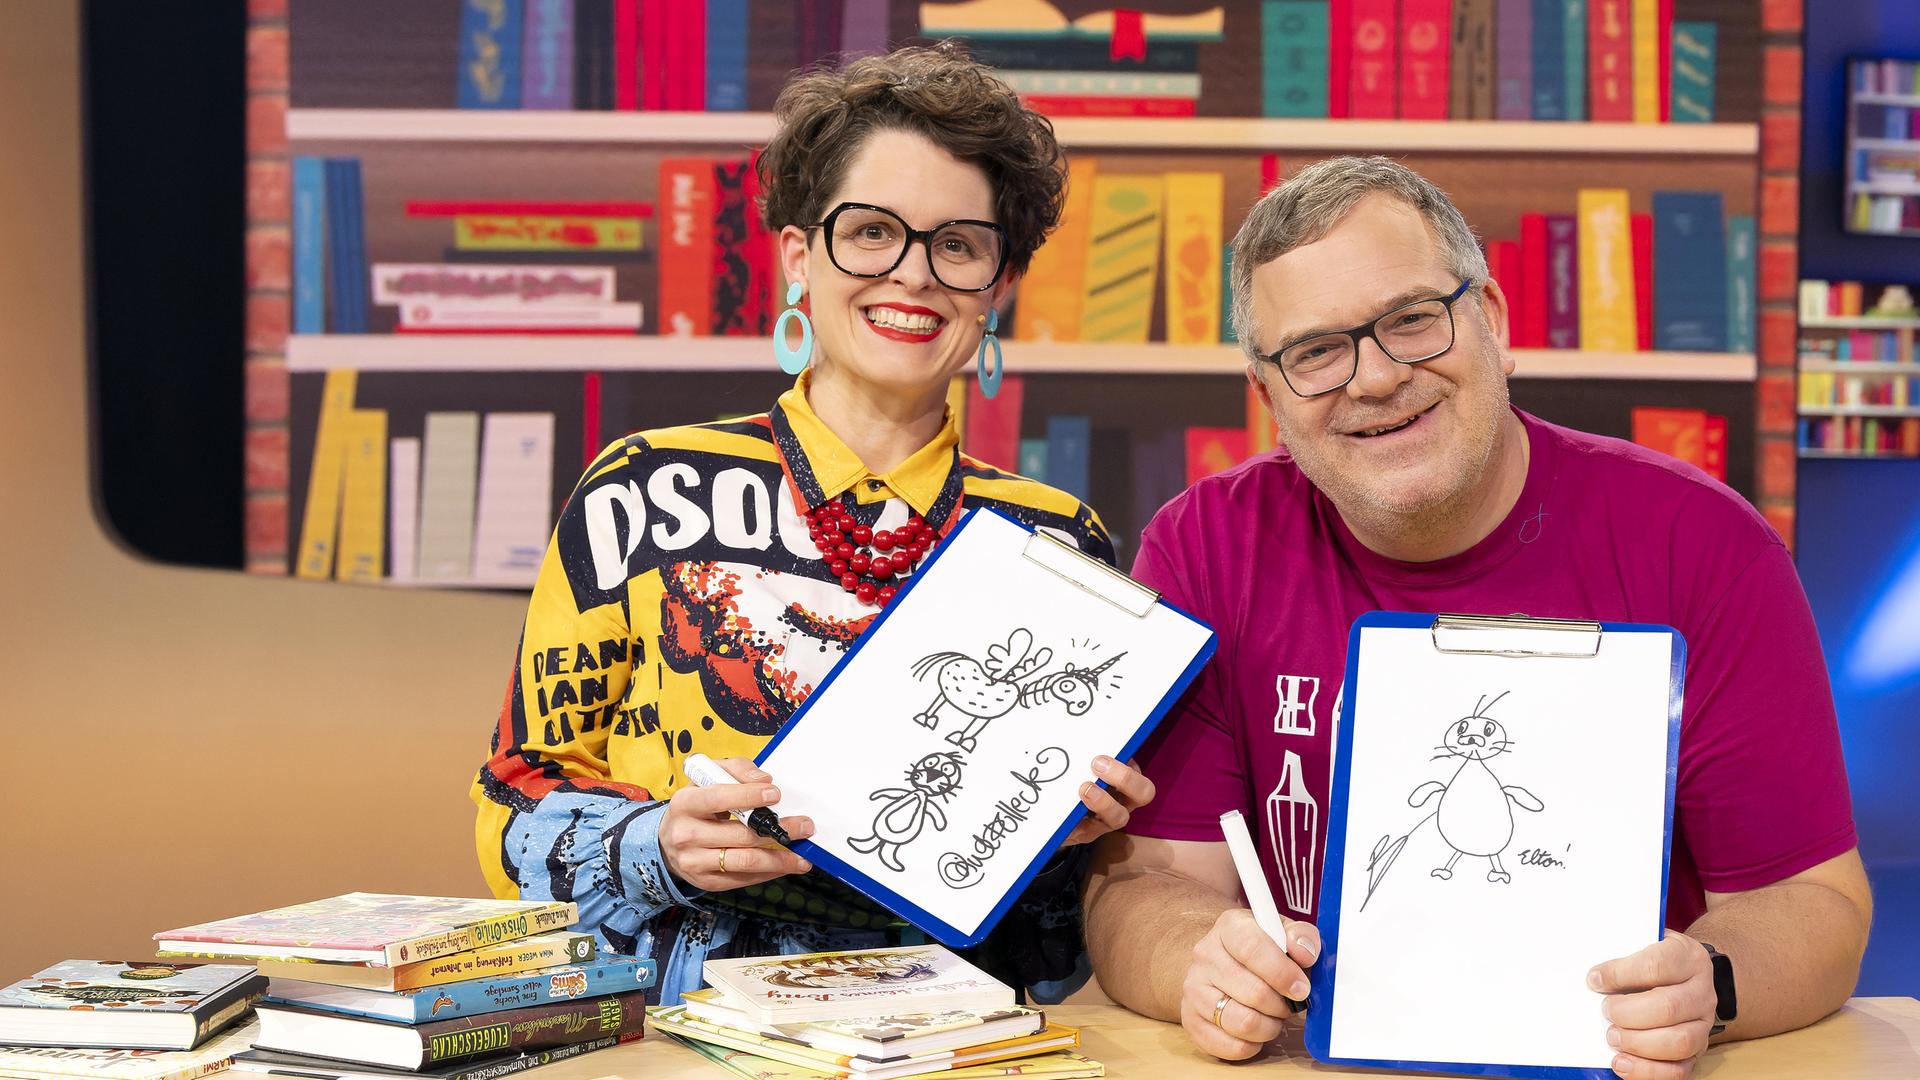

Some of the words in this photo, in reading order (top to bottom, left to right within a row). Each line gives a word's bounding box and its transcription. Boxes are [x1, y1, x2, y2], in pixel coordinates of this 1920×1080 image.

[517, 952, 538, 962] WEGER
[430, 961, 462, 977] Internat
[463, 962, 472, 971] im
[484, 984, 520, 997] Samstage
[493, 994, 520, 1005] Woche
[522, 992, 538, 1002] Eine
